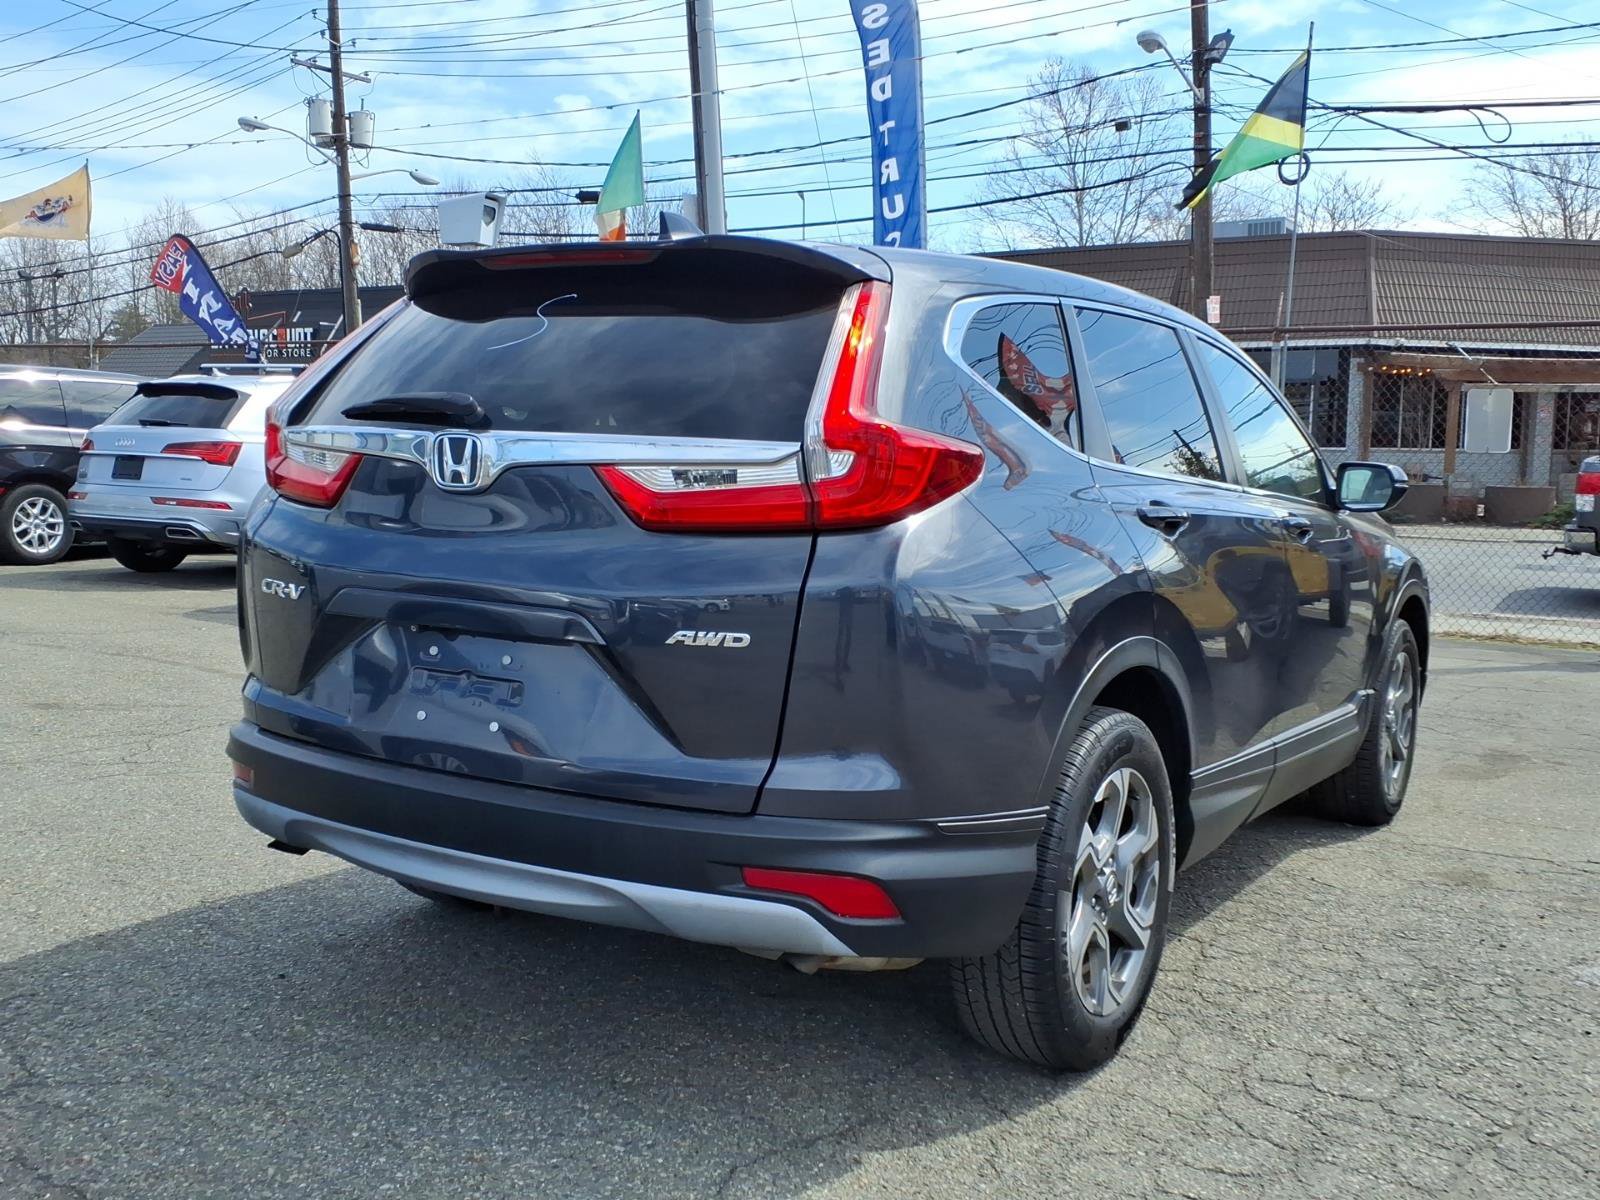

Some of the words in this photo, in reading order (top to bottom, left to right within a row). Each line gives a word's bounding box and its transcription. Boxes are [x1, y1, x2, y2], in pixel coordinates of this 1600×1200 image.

[282, 348, 311, 358] STORE
[261, 578, 306, 600] CR-V
[665, 630, 751, 648] AWD
